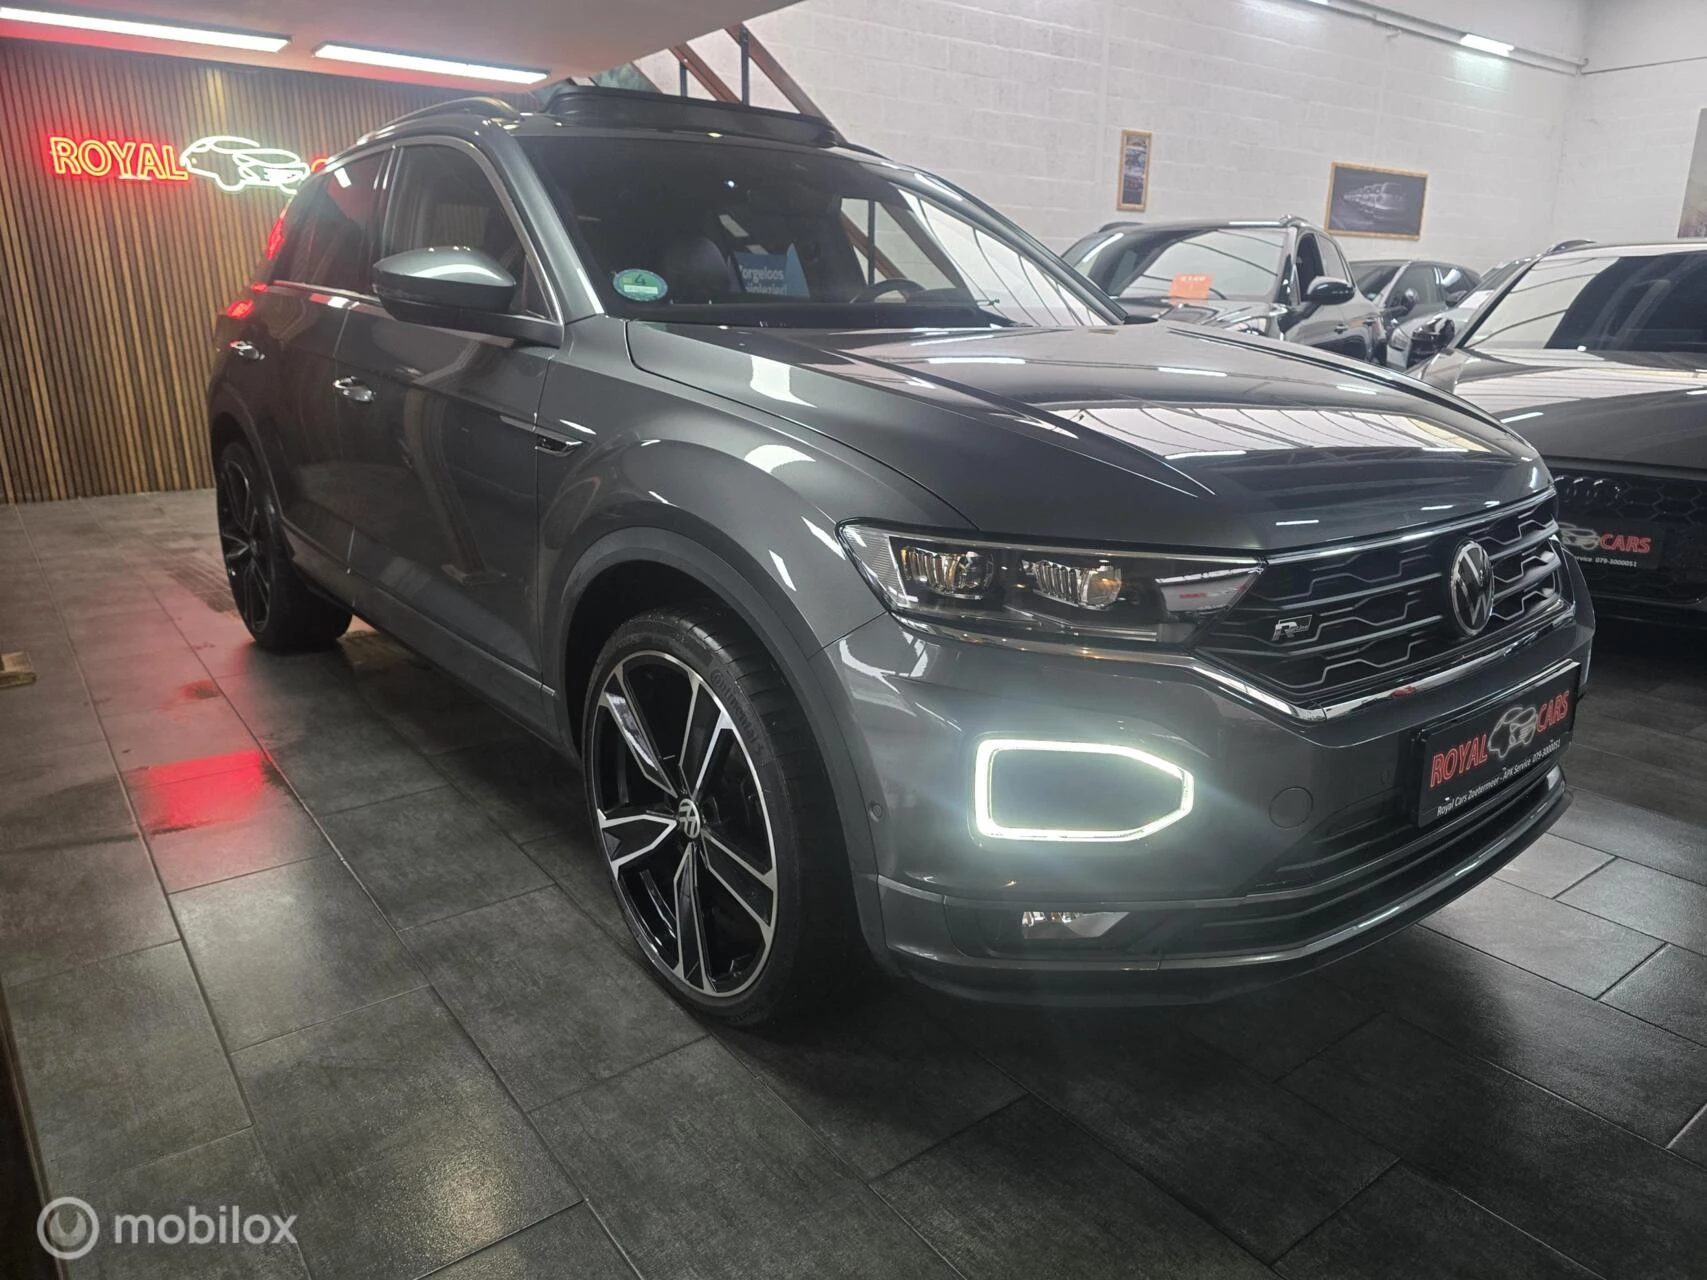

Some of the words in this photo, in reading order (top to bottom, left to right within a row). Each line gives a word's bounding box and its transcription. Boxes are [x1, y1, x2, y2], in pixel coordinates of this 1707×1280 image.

[50, 136, 189, 180] ROYAL
[739, 264, 784, 283] orgeloos
[1600, 533, 1651, 553] CARS
[1430, 734, 1488, 788] ROYAL
[1536, 690, 1569, 732] CARS
[1437, 798, 1455, 816] Royal
[1455, 795, 1468, 807] Cars
